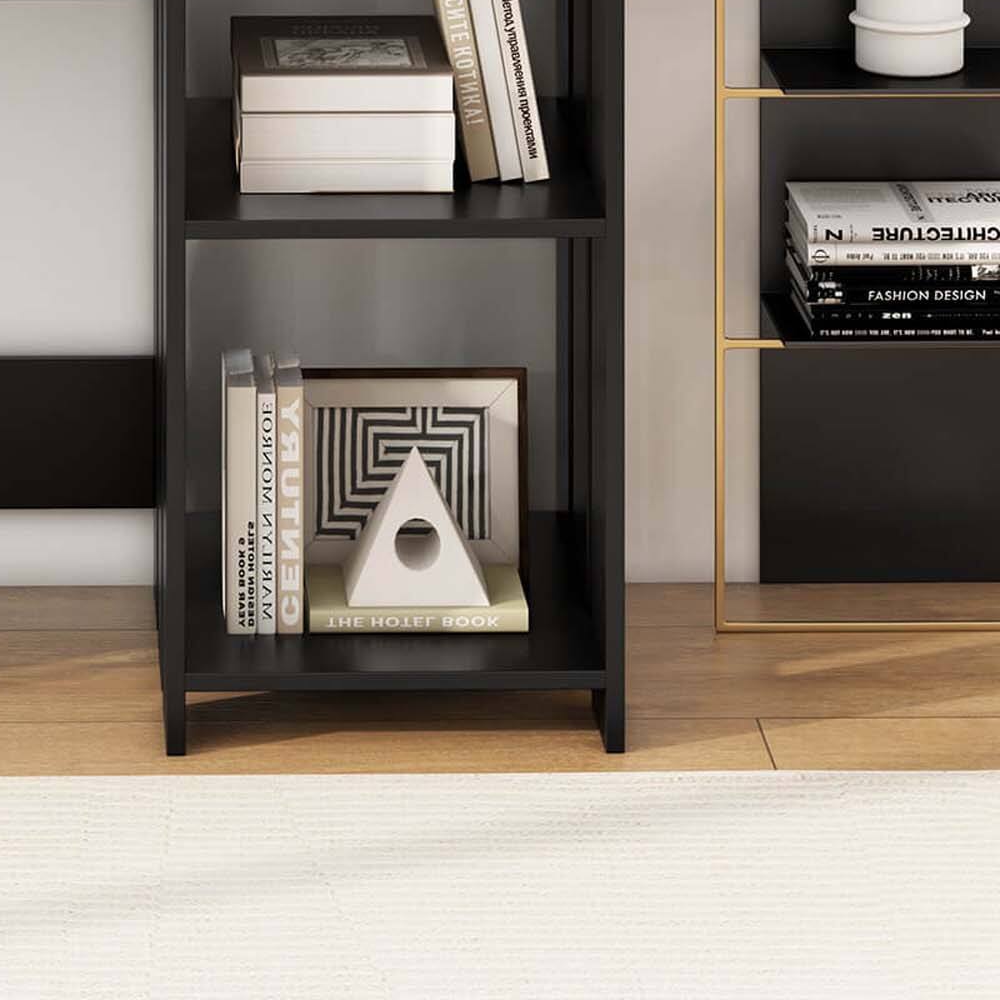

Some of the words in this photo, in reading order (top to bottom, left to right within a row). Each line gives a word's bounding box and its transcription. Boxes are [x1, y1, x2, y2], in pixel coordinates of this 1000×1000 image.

[454, 46, 486, 126] КОТИКА!
[518, 99, 539, 160] проектами
[872, 227, 1000, 241] CHITECTURE
[868, 290, 930, 301] FASHION
[934, 289, 986, 301] DESIGN
[882, 312, 912, 320] zen
